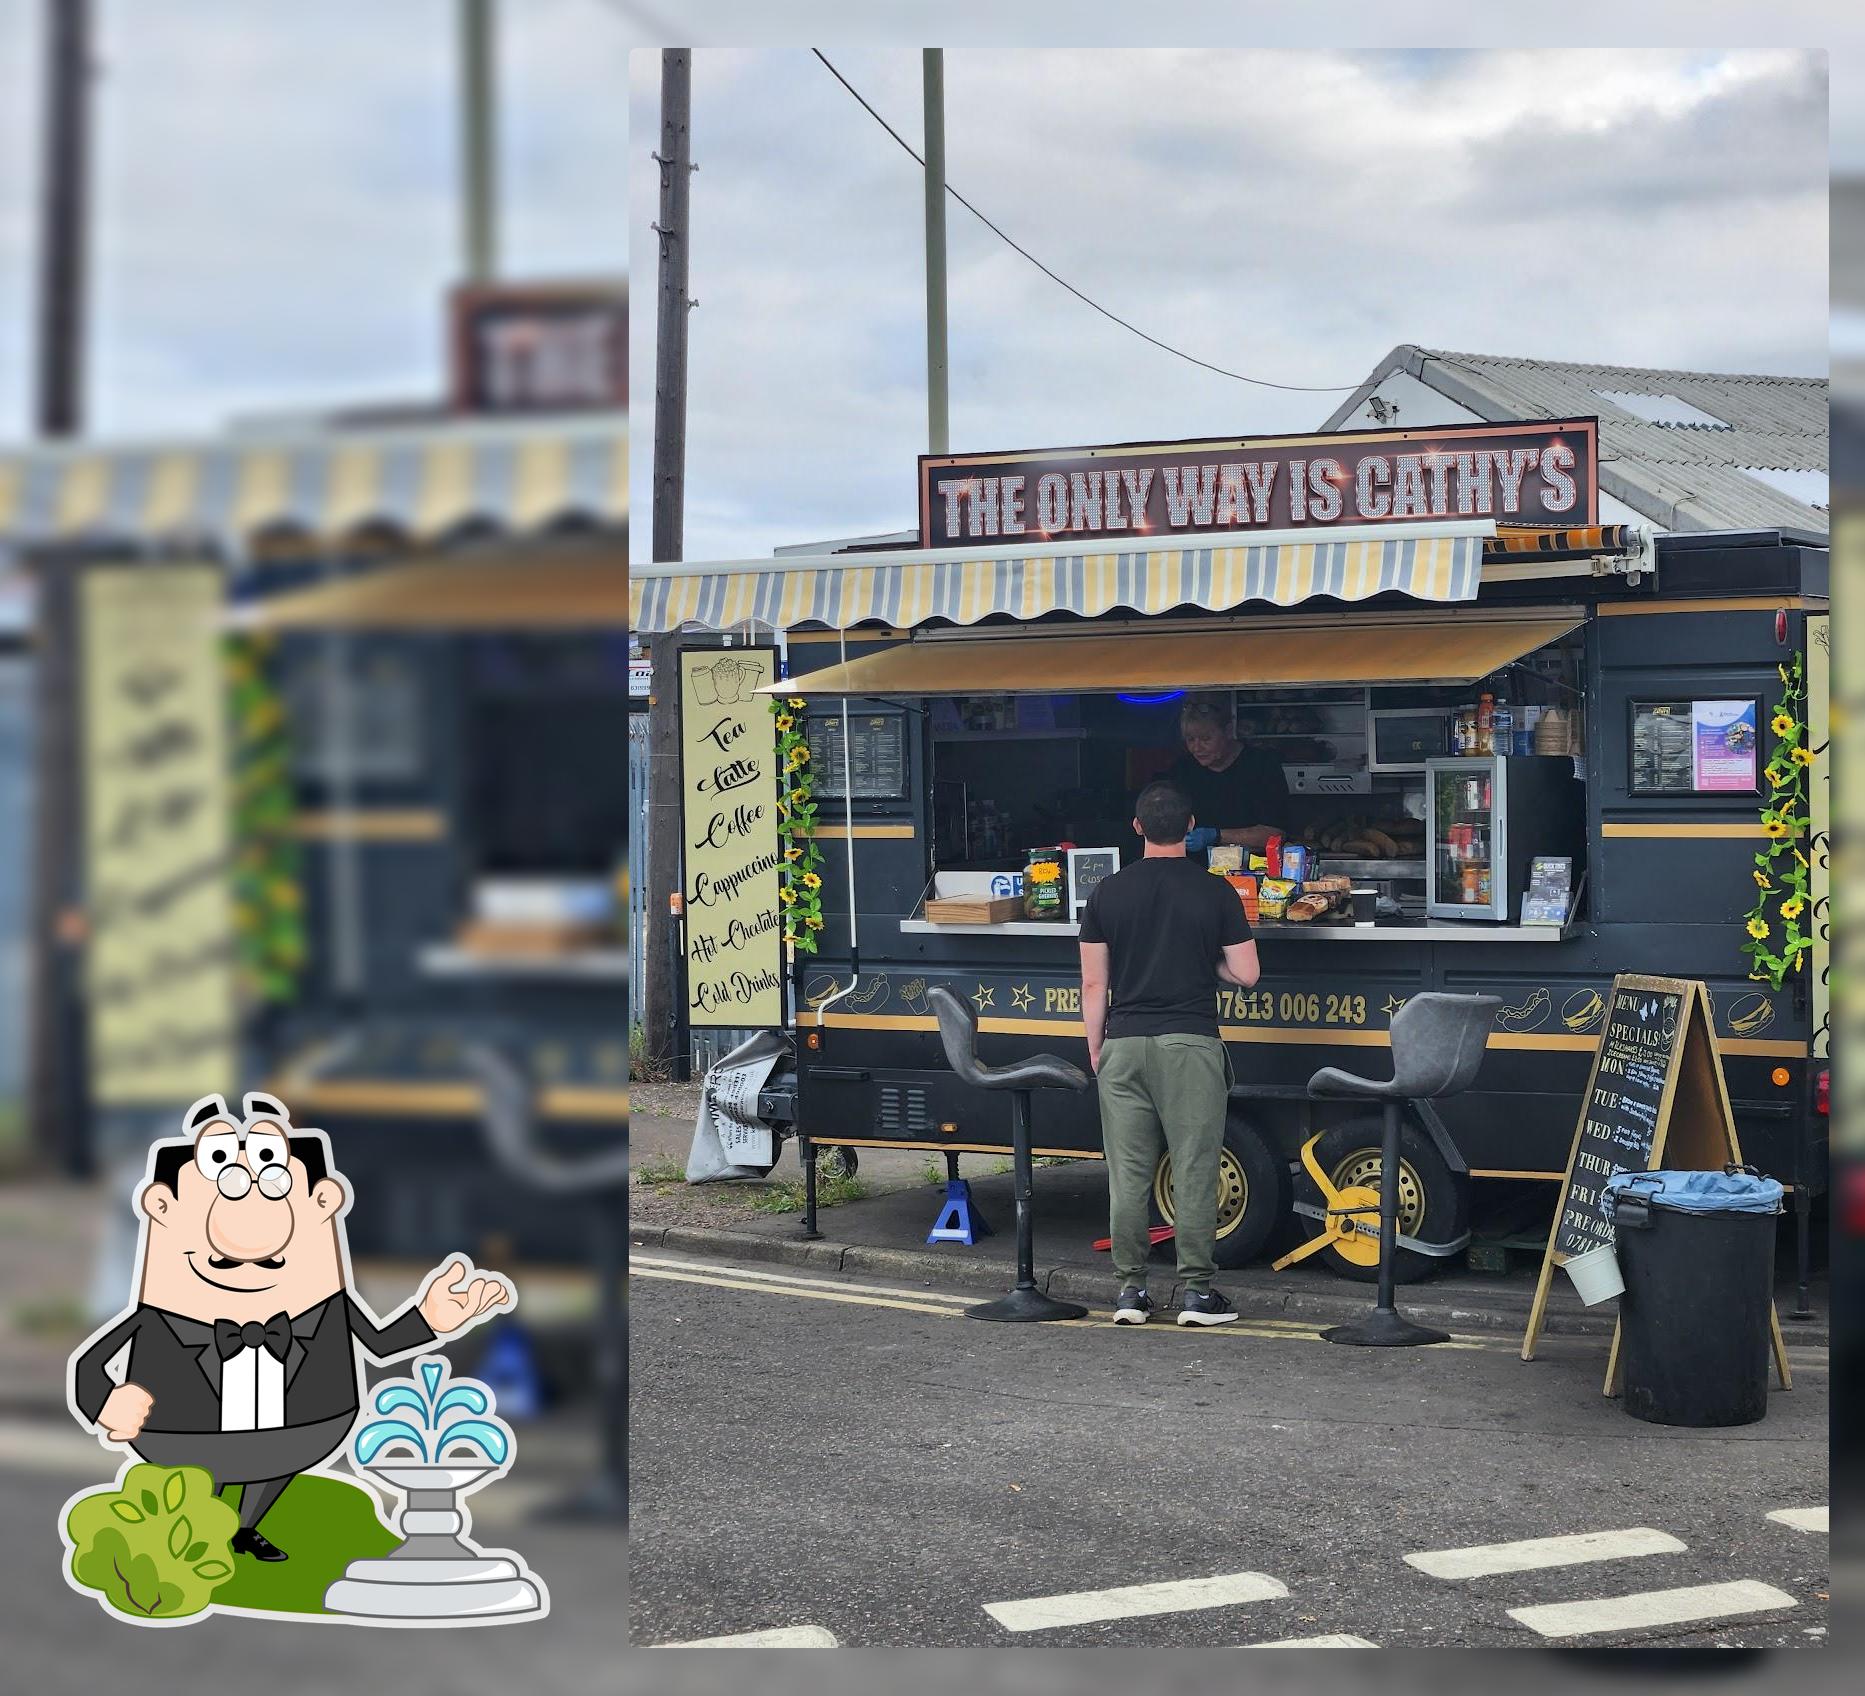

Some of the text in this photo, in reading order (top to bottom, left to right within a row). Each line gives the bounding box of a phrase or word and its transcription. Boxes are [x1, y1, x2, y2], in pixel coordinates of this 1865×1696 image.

[938, 446, 1576, 537] THE ONLY WAY IS CATHY'S
[696, 717, 747, 752] Tea
[695, 804, 765, 848] Coffee
[687, 851, 779, 906] Cappuccino
[691, 934, 719, 963] Hot
[691, 968, 780, 1013] Cold Drinks
[1279, 992, 1320, 1022] 006
[1325, 994, 1367, 1024] 243
[1615, 994, 1640, 1012] MENU
[1564, 1209, 1591, 1231] PRE
